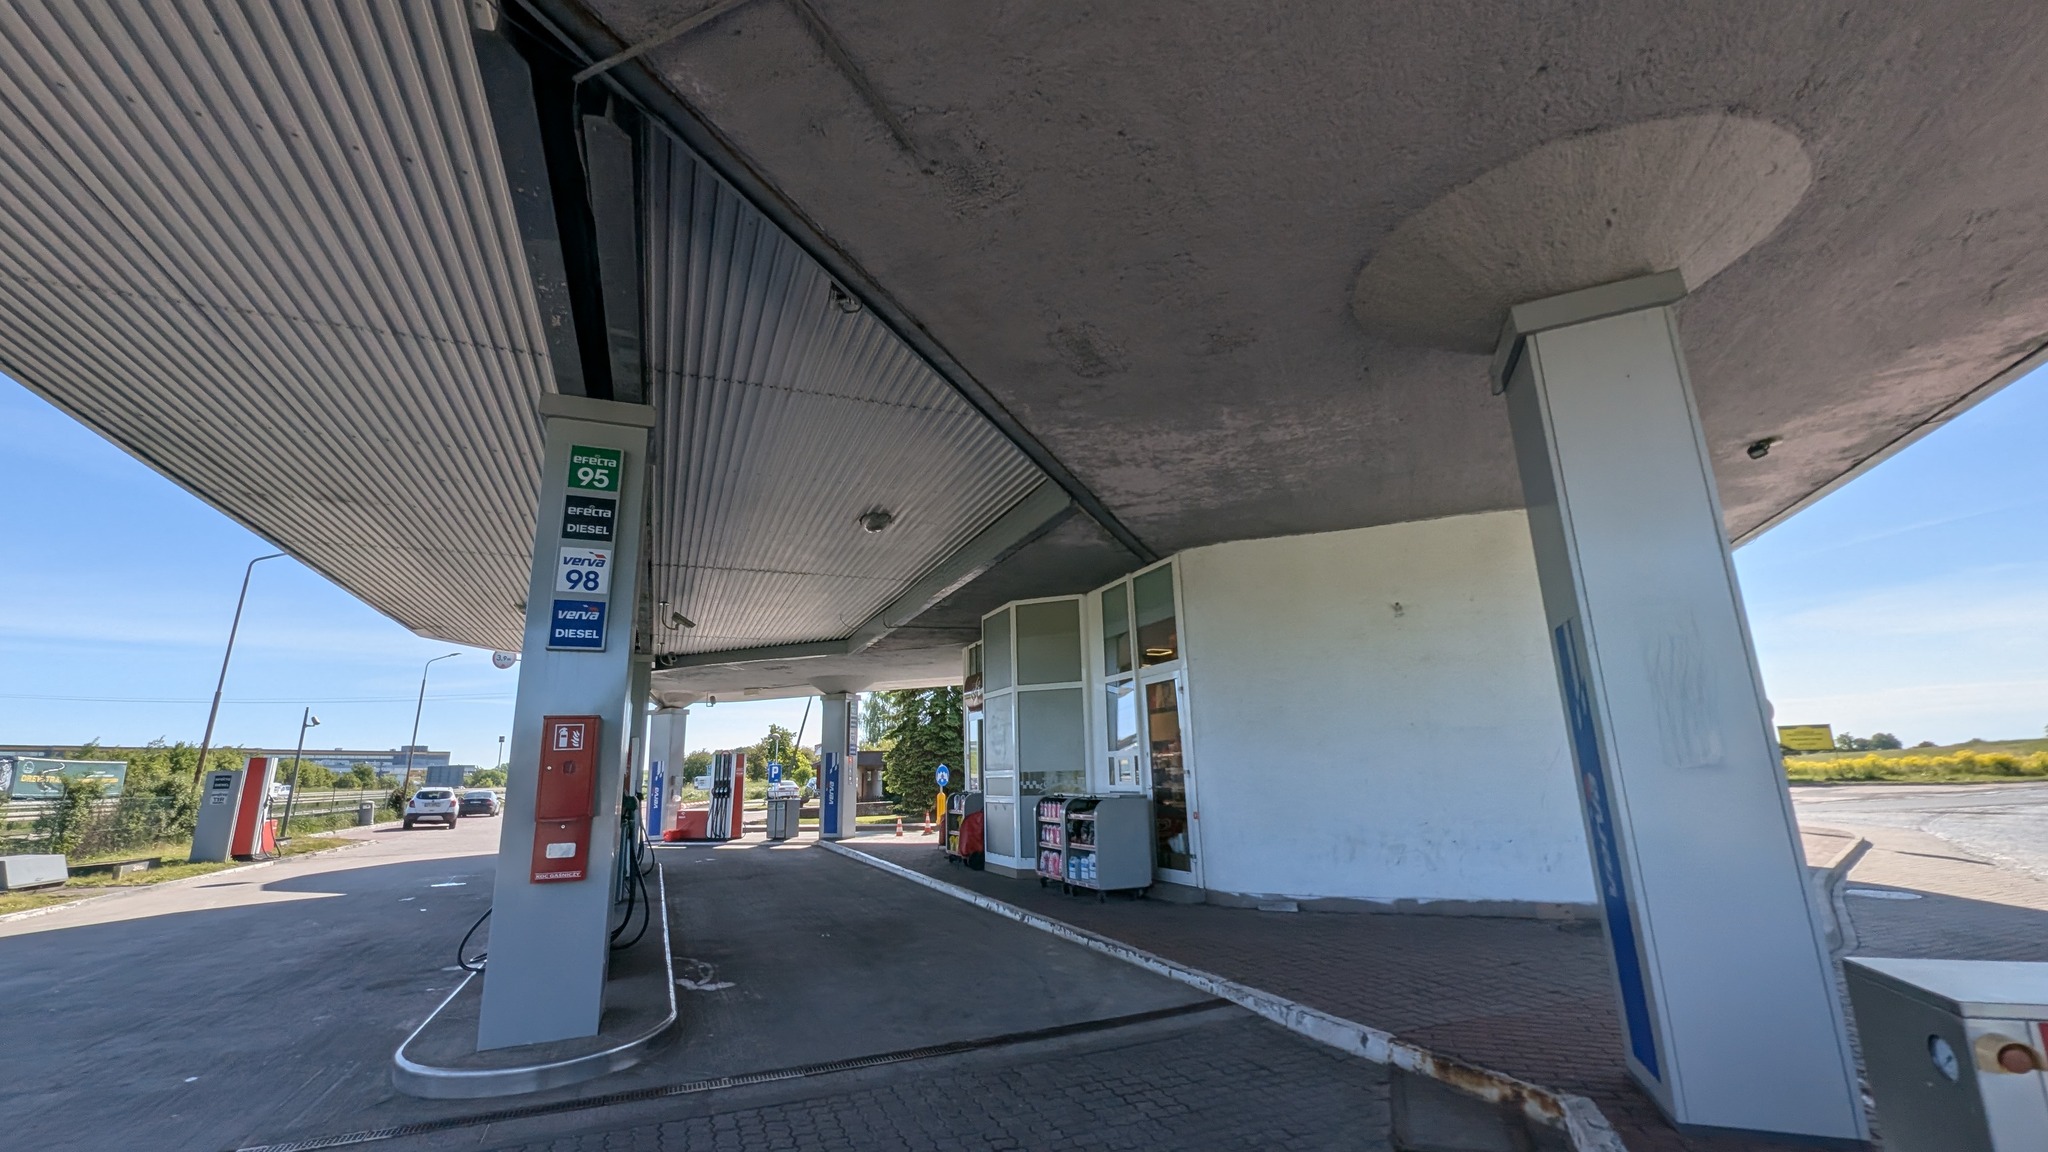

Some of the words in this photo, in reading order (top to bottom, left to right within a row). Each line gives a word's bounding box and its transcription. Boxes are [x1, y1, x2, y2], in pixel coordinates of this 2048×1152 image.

[577, 467, 610, 488] 95
[566, 523, 610, 535] DIESEL
[563, 556, 606, 568] verva
[565, 569, 600, 591] 98
[558, 610, 600, 620] verva
[555, 628, 600, 639] DIESEL
[771, 766, 779, 778] P
